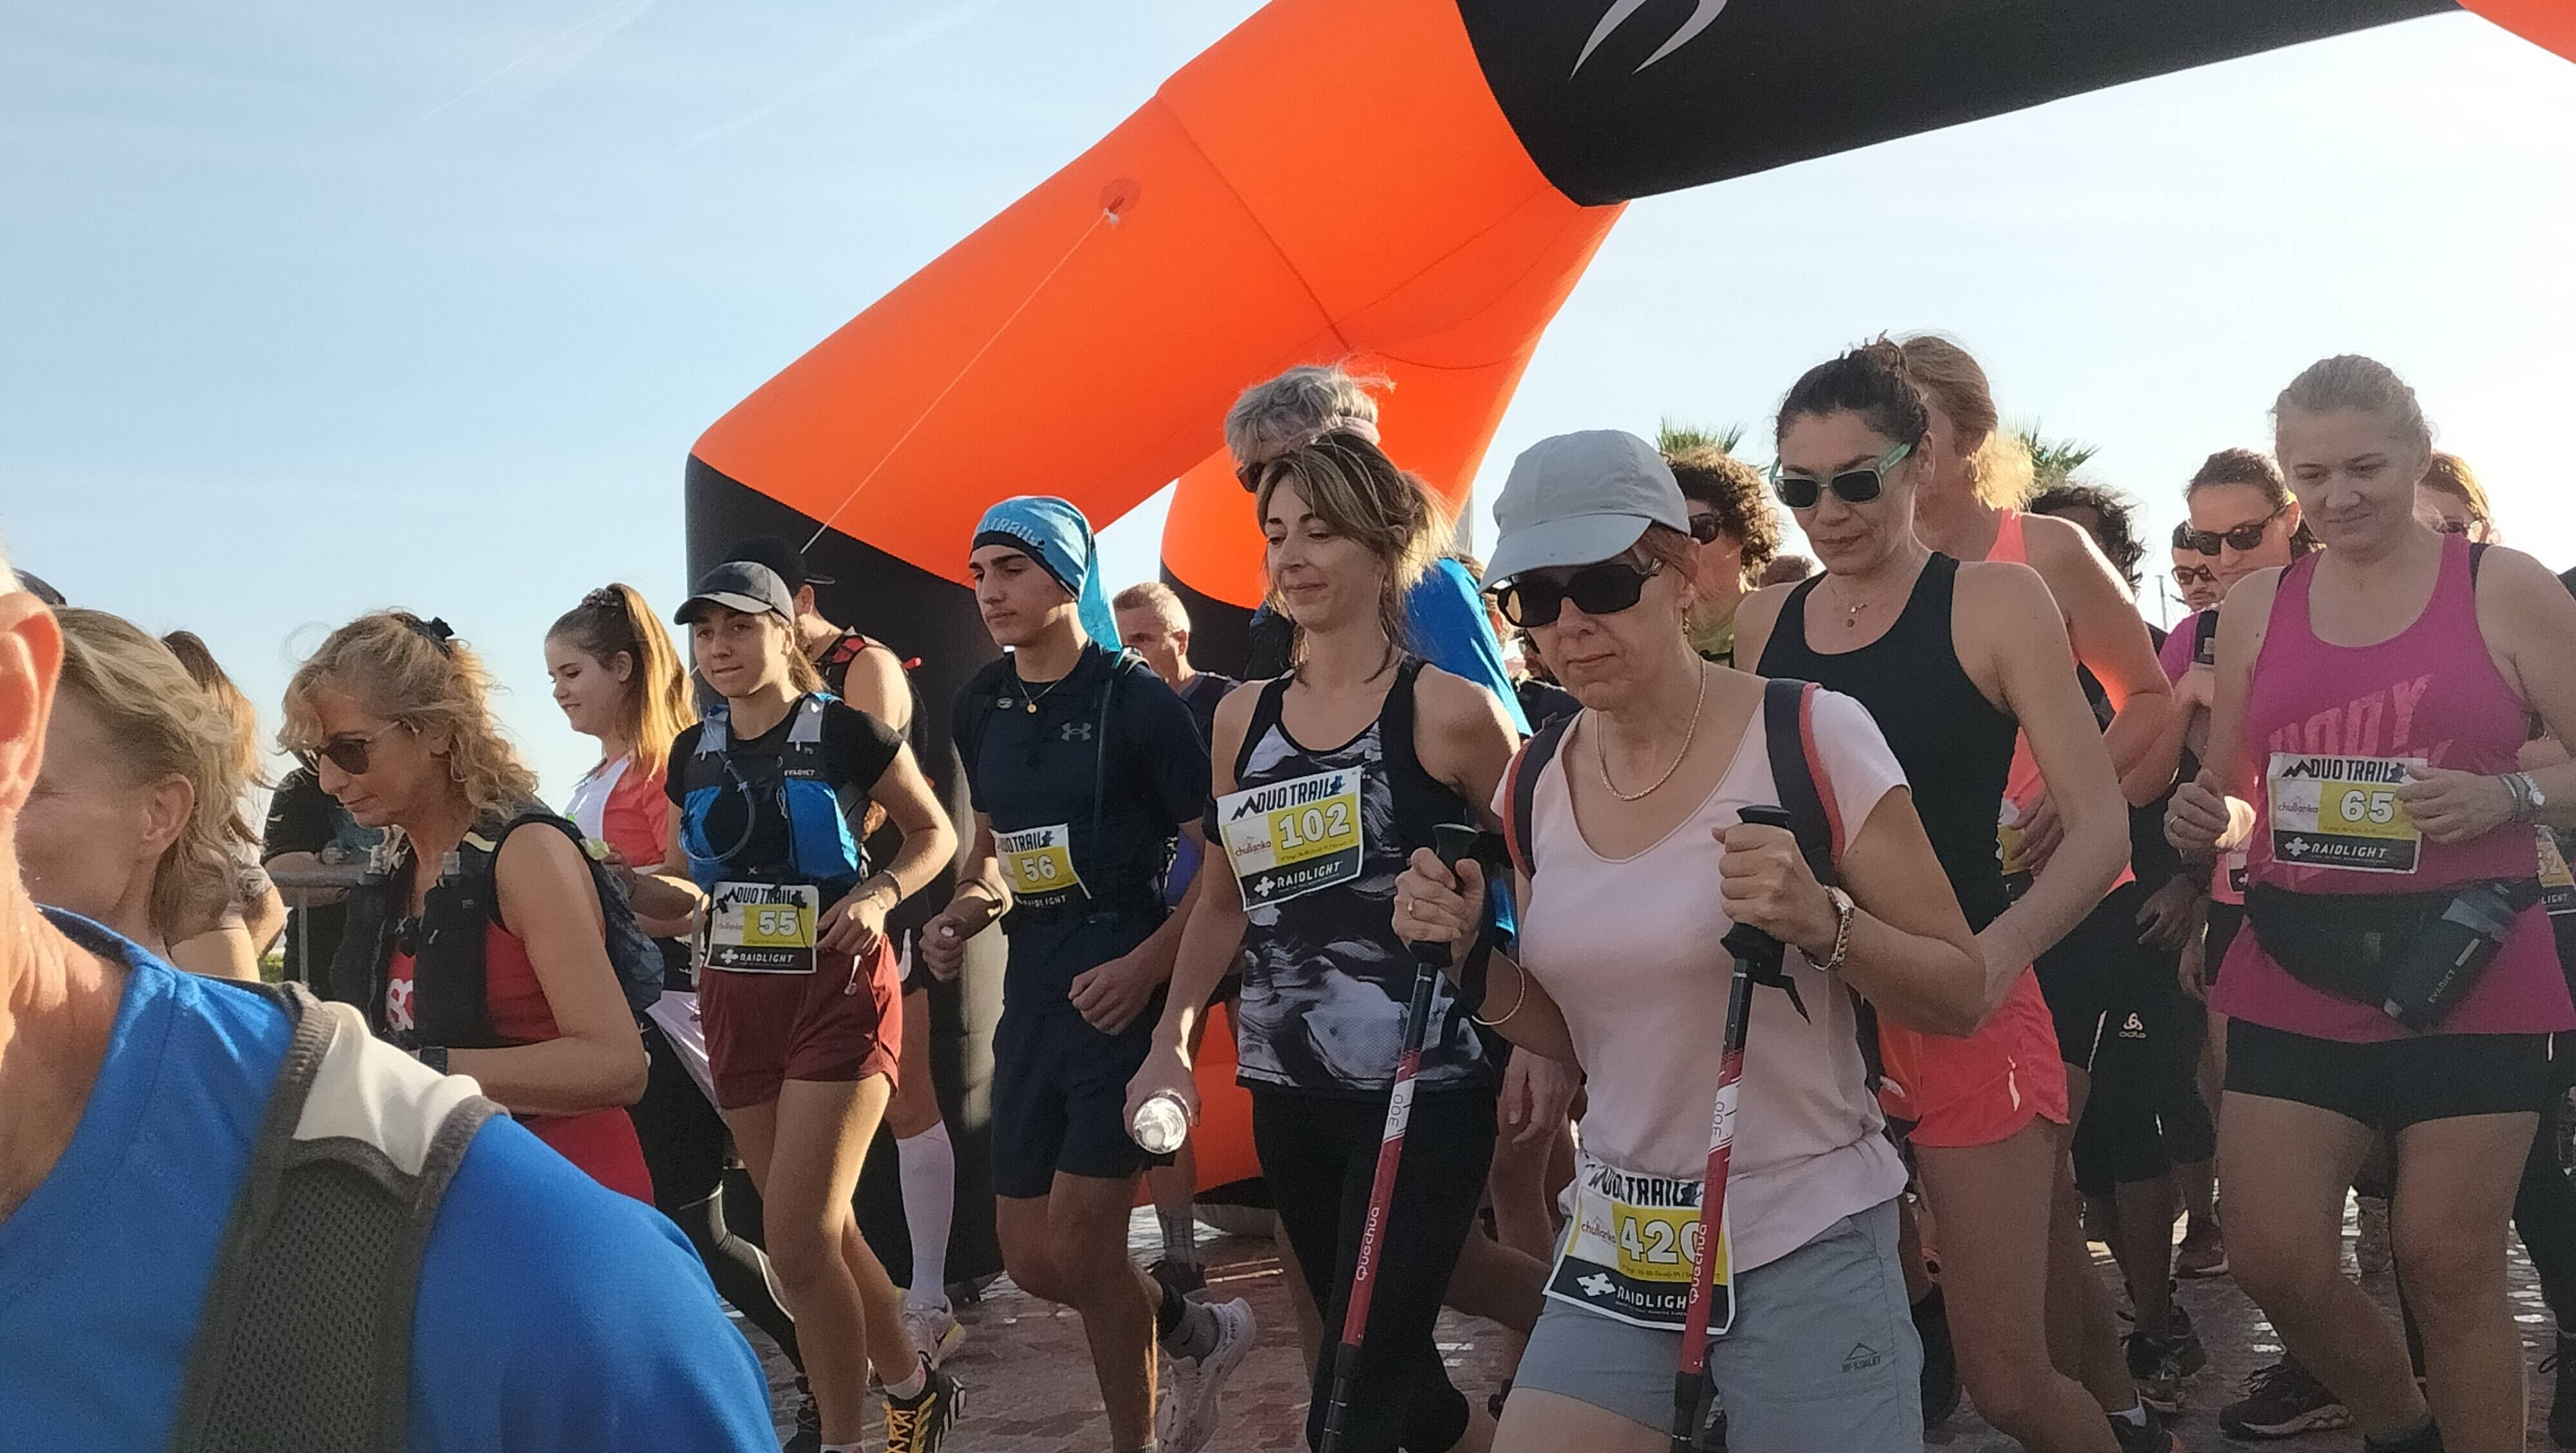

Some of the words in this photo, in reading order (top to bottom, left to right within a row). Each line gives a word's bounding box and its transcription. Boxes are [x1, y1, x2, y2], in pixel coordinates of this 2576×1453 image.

[2309, 758, 2344, 780] DUO
[2345, 760, 2392, 783] TRAIL
[1256, 787, 1288, 814] DUO
[1289, 777, 1334, 805] TRAIL
[2339, 789, 2396, 824] 65
[1278, 802, 1351, 851] 102
[1012, 831, 1042, 852] TRAIL
[2311, 842, 2387, 859] RAIDLIGHT
[1021, 855, 1057, 882] 56
[1277, 860, 1343, 889] RAIDLIGHT
[2541, 893, 2568, 905] LIGHT
[758, 909, 797, 936] 55
[740, 953, 794, 964] RAIDLIGHT
[1388, 1094, 1404, 1128] 300
[1625, 1175, 1683, 1207] TRAIL
[1356, 1206, 1380, 1281] Quechua
[1689, 1224, 1708, 1305] Quechua
[1616, 1286, 1687, 1309] RAIDLIGH
